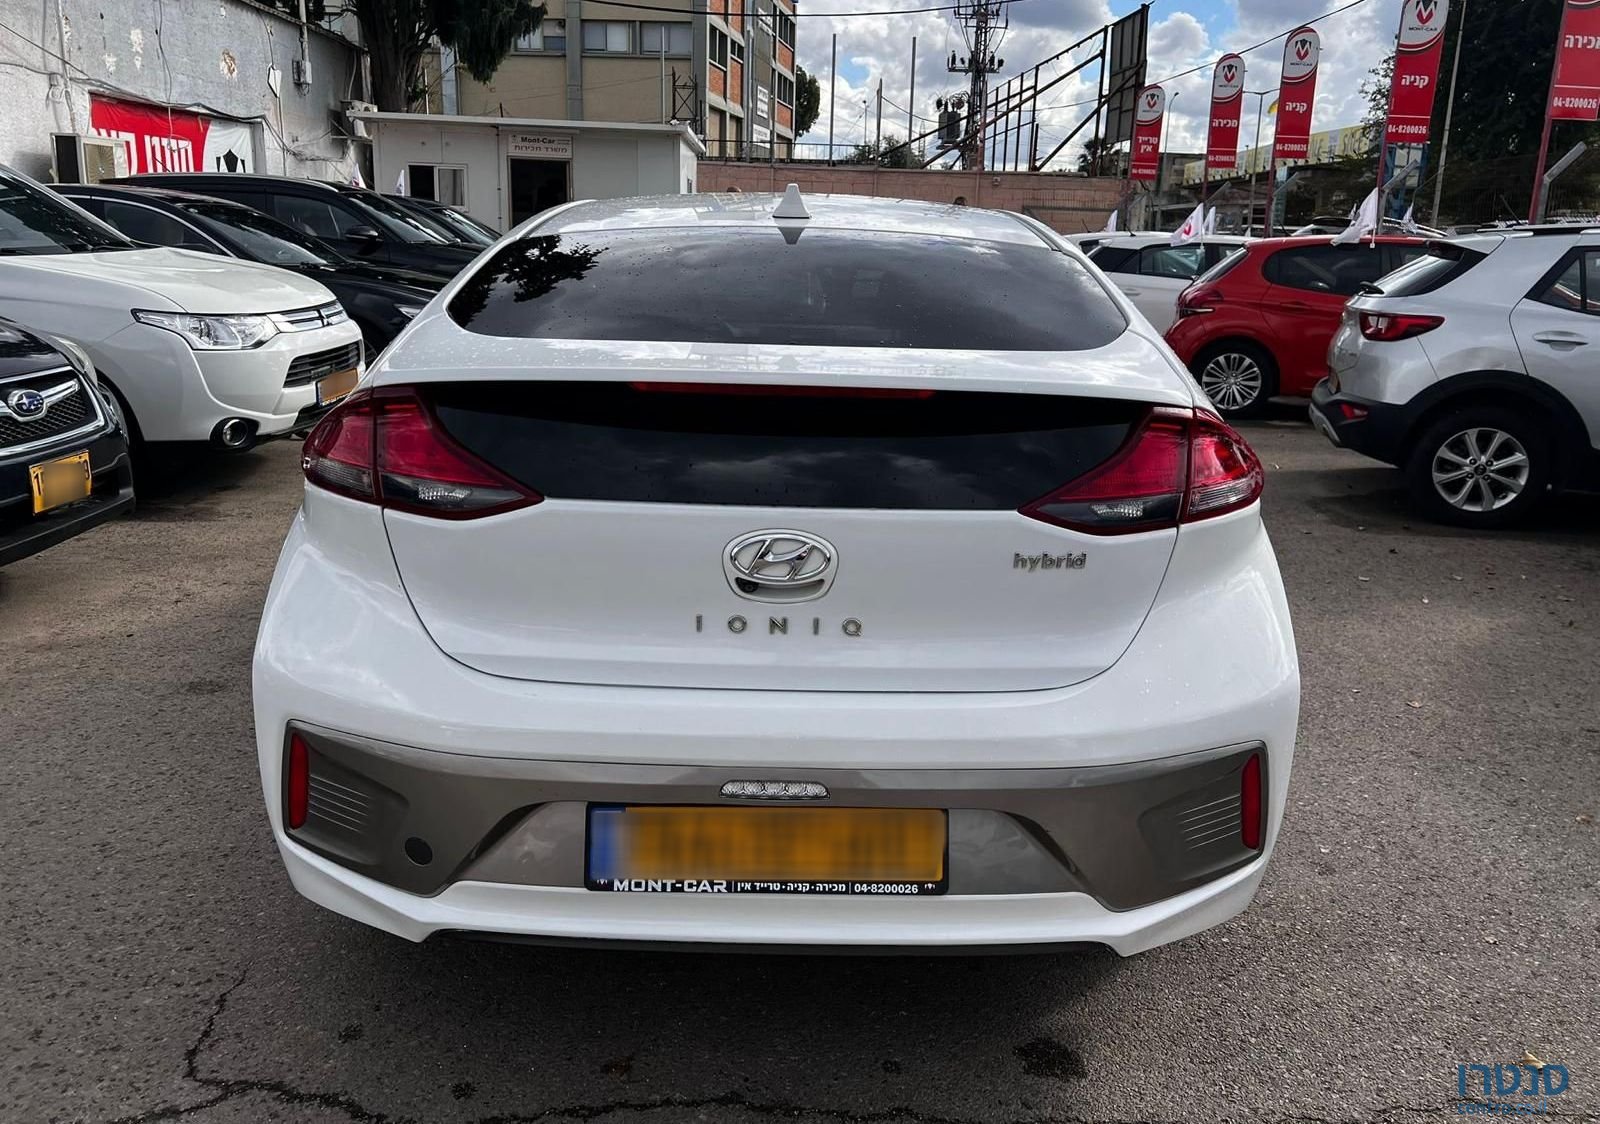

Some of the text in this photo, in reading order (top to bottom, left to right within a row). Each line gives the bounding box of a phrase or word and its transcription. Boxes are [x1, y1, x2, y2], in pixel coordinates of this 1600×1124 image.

[1401, 75, 1430, 88] קניה
[1285, 102, 1307, 113] קניה
[1553, 97, 1598, 109] 04-8200026
[1212, 119, 1238, 127] מכירה
[1388, 125, 1427, 134] 04-8200026
[520, 136, 556, 144] Mont-Car
[1137, 136, 1158, 144] טרייד
[1140, 145, 1153, 153] אין
[1013, 552, 1087, 573] hybrid
[696, 613, 863, 637] IONIQ
[613, 879, 728, 892] MONT-CAR
[737, 882, 751, 892] אין
[854, 883, 919, 894] 04-8200026
